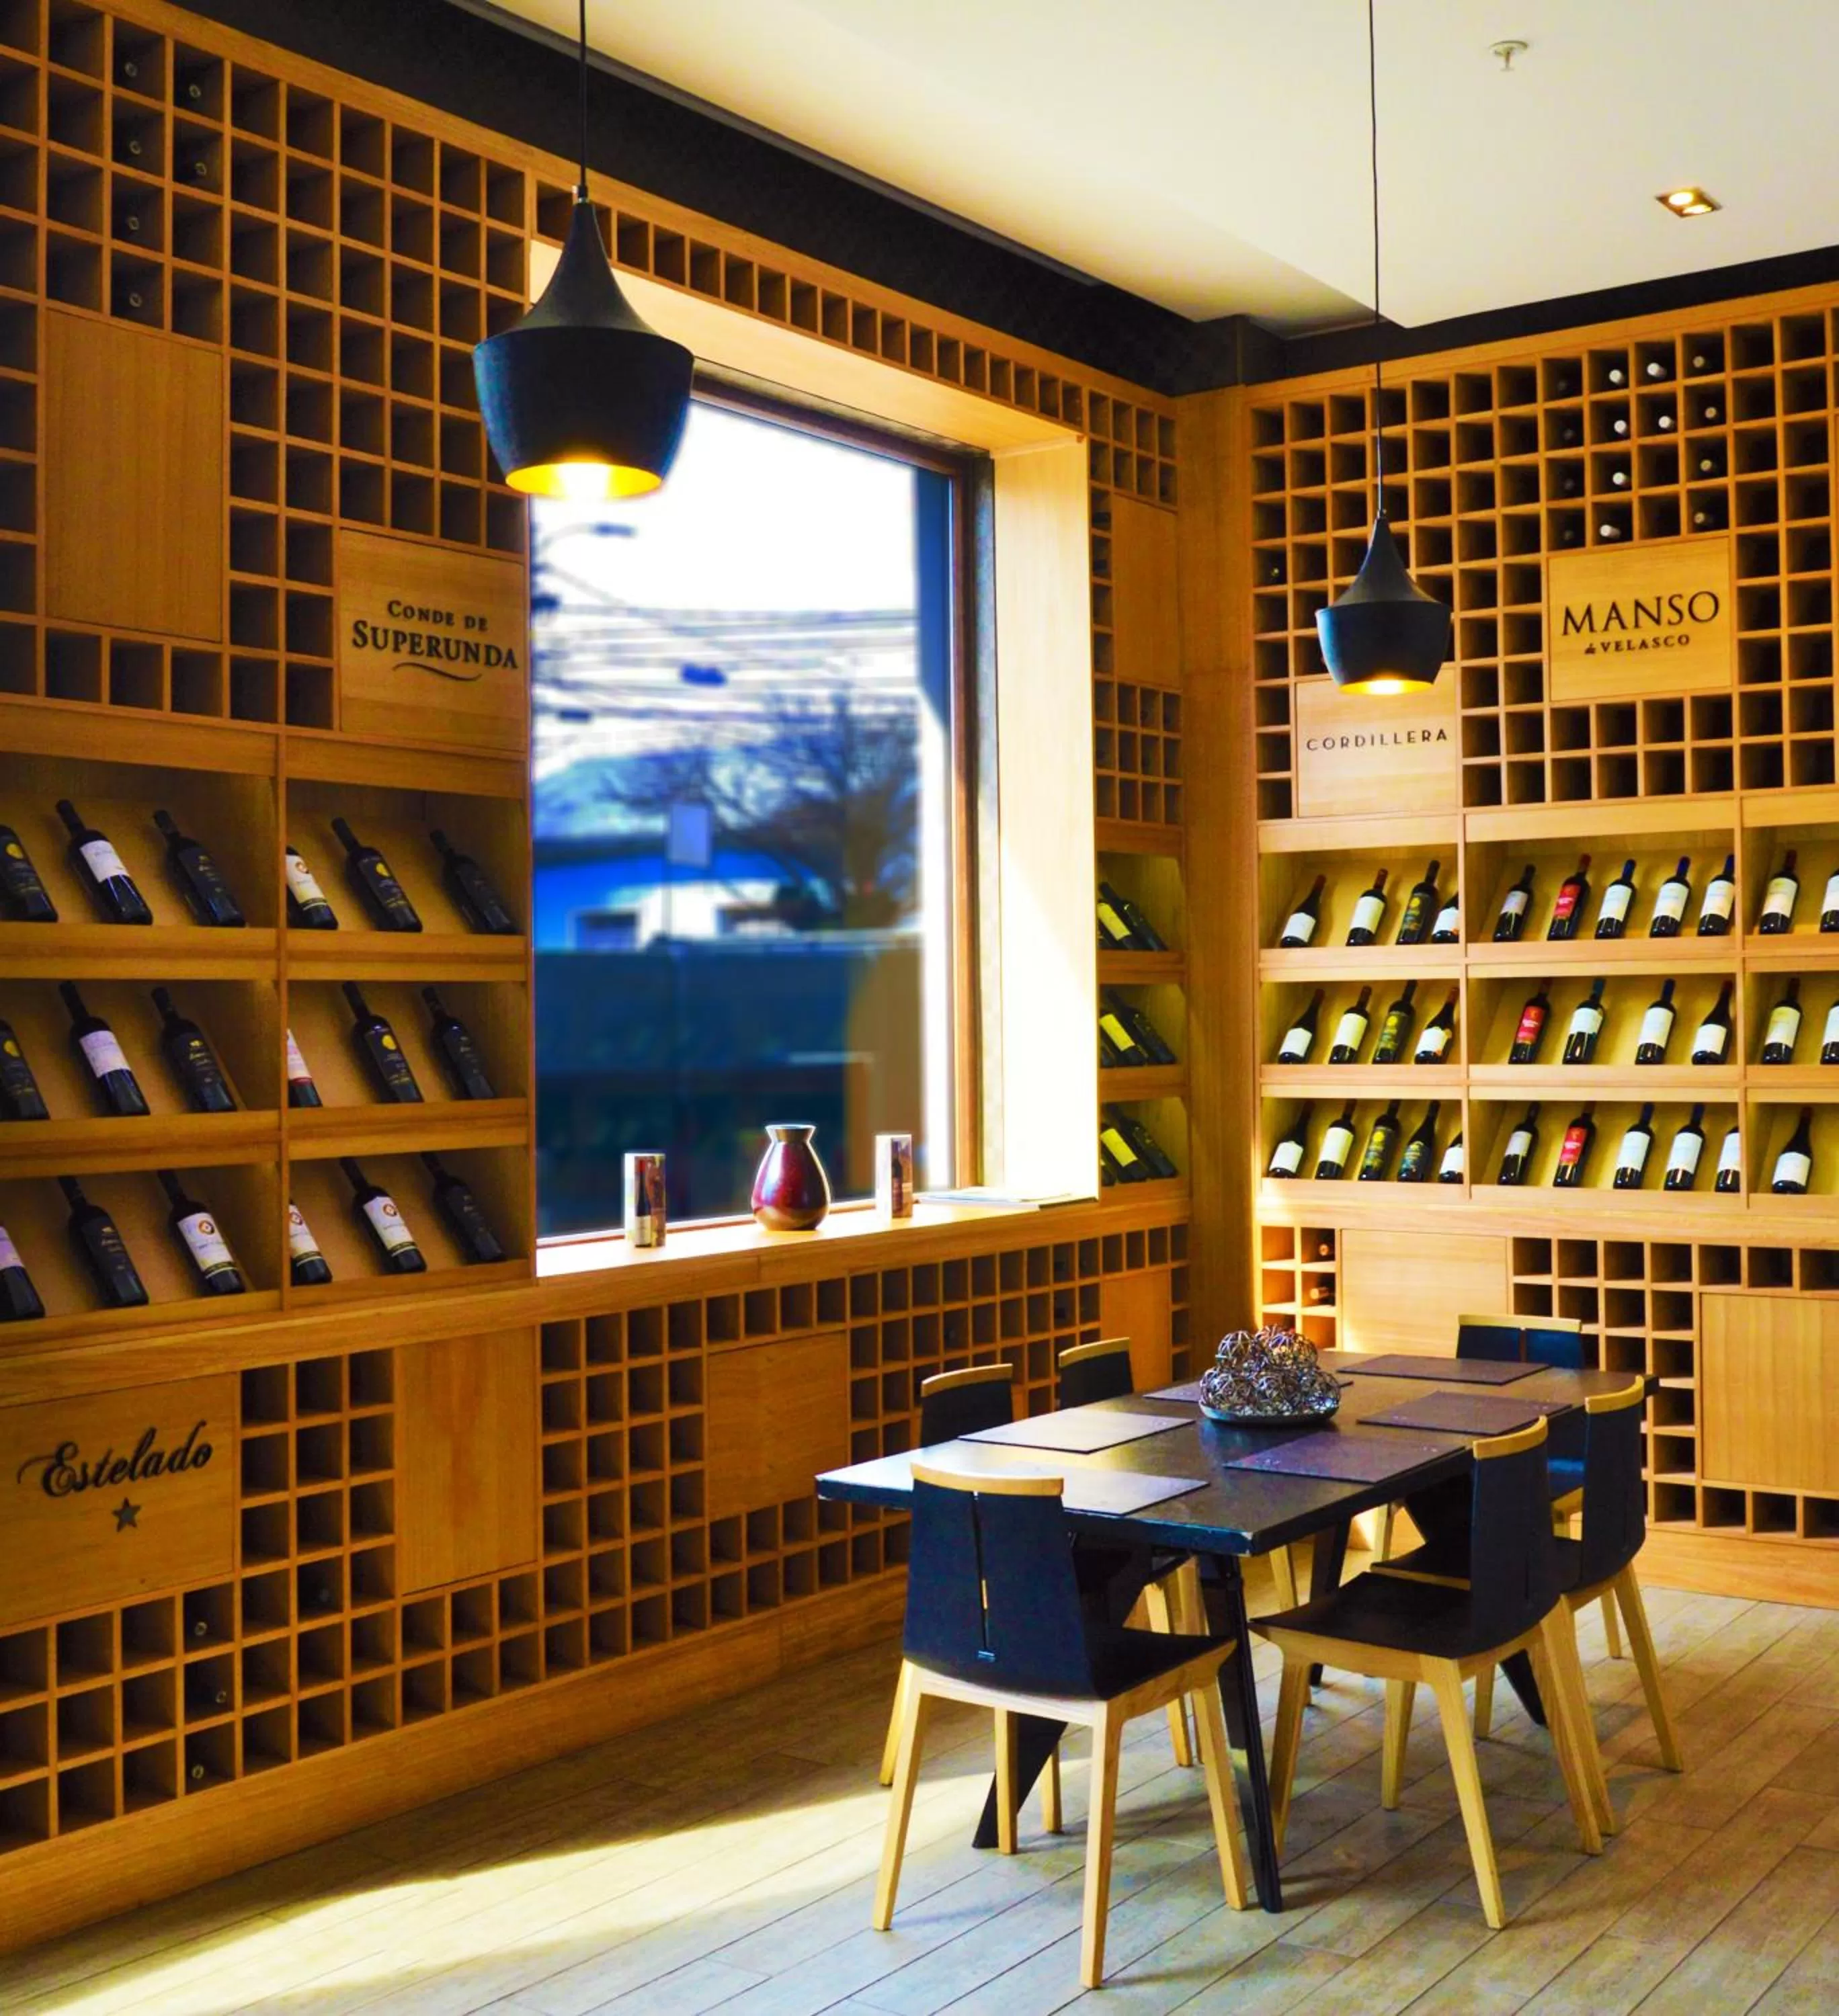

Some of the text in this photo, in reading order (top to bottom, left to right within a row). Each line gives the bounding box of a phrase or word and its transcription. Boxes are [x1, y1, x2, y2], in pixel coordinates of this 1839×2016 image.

[386, 599, 489, 632] CONDE DE
[1561, 591, 1719, 636] MANSO
[352, 620, 519, 669] SUPERUNDA
[1600, 634, 1690, 653] VELASCO
[1306, 728, 1448, 751] CORDILLERA
[16, 1419, 214, 1498] Estelado
